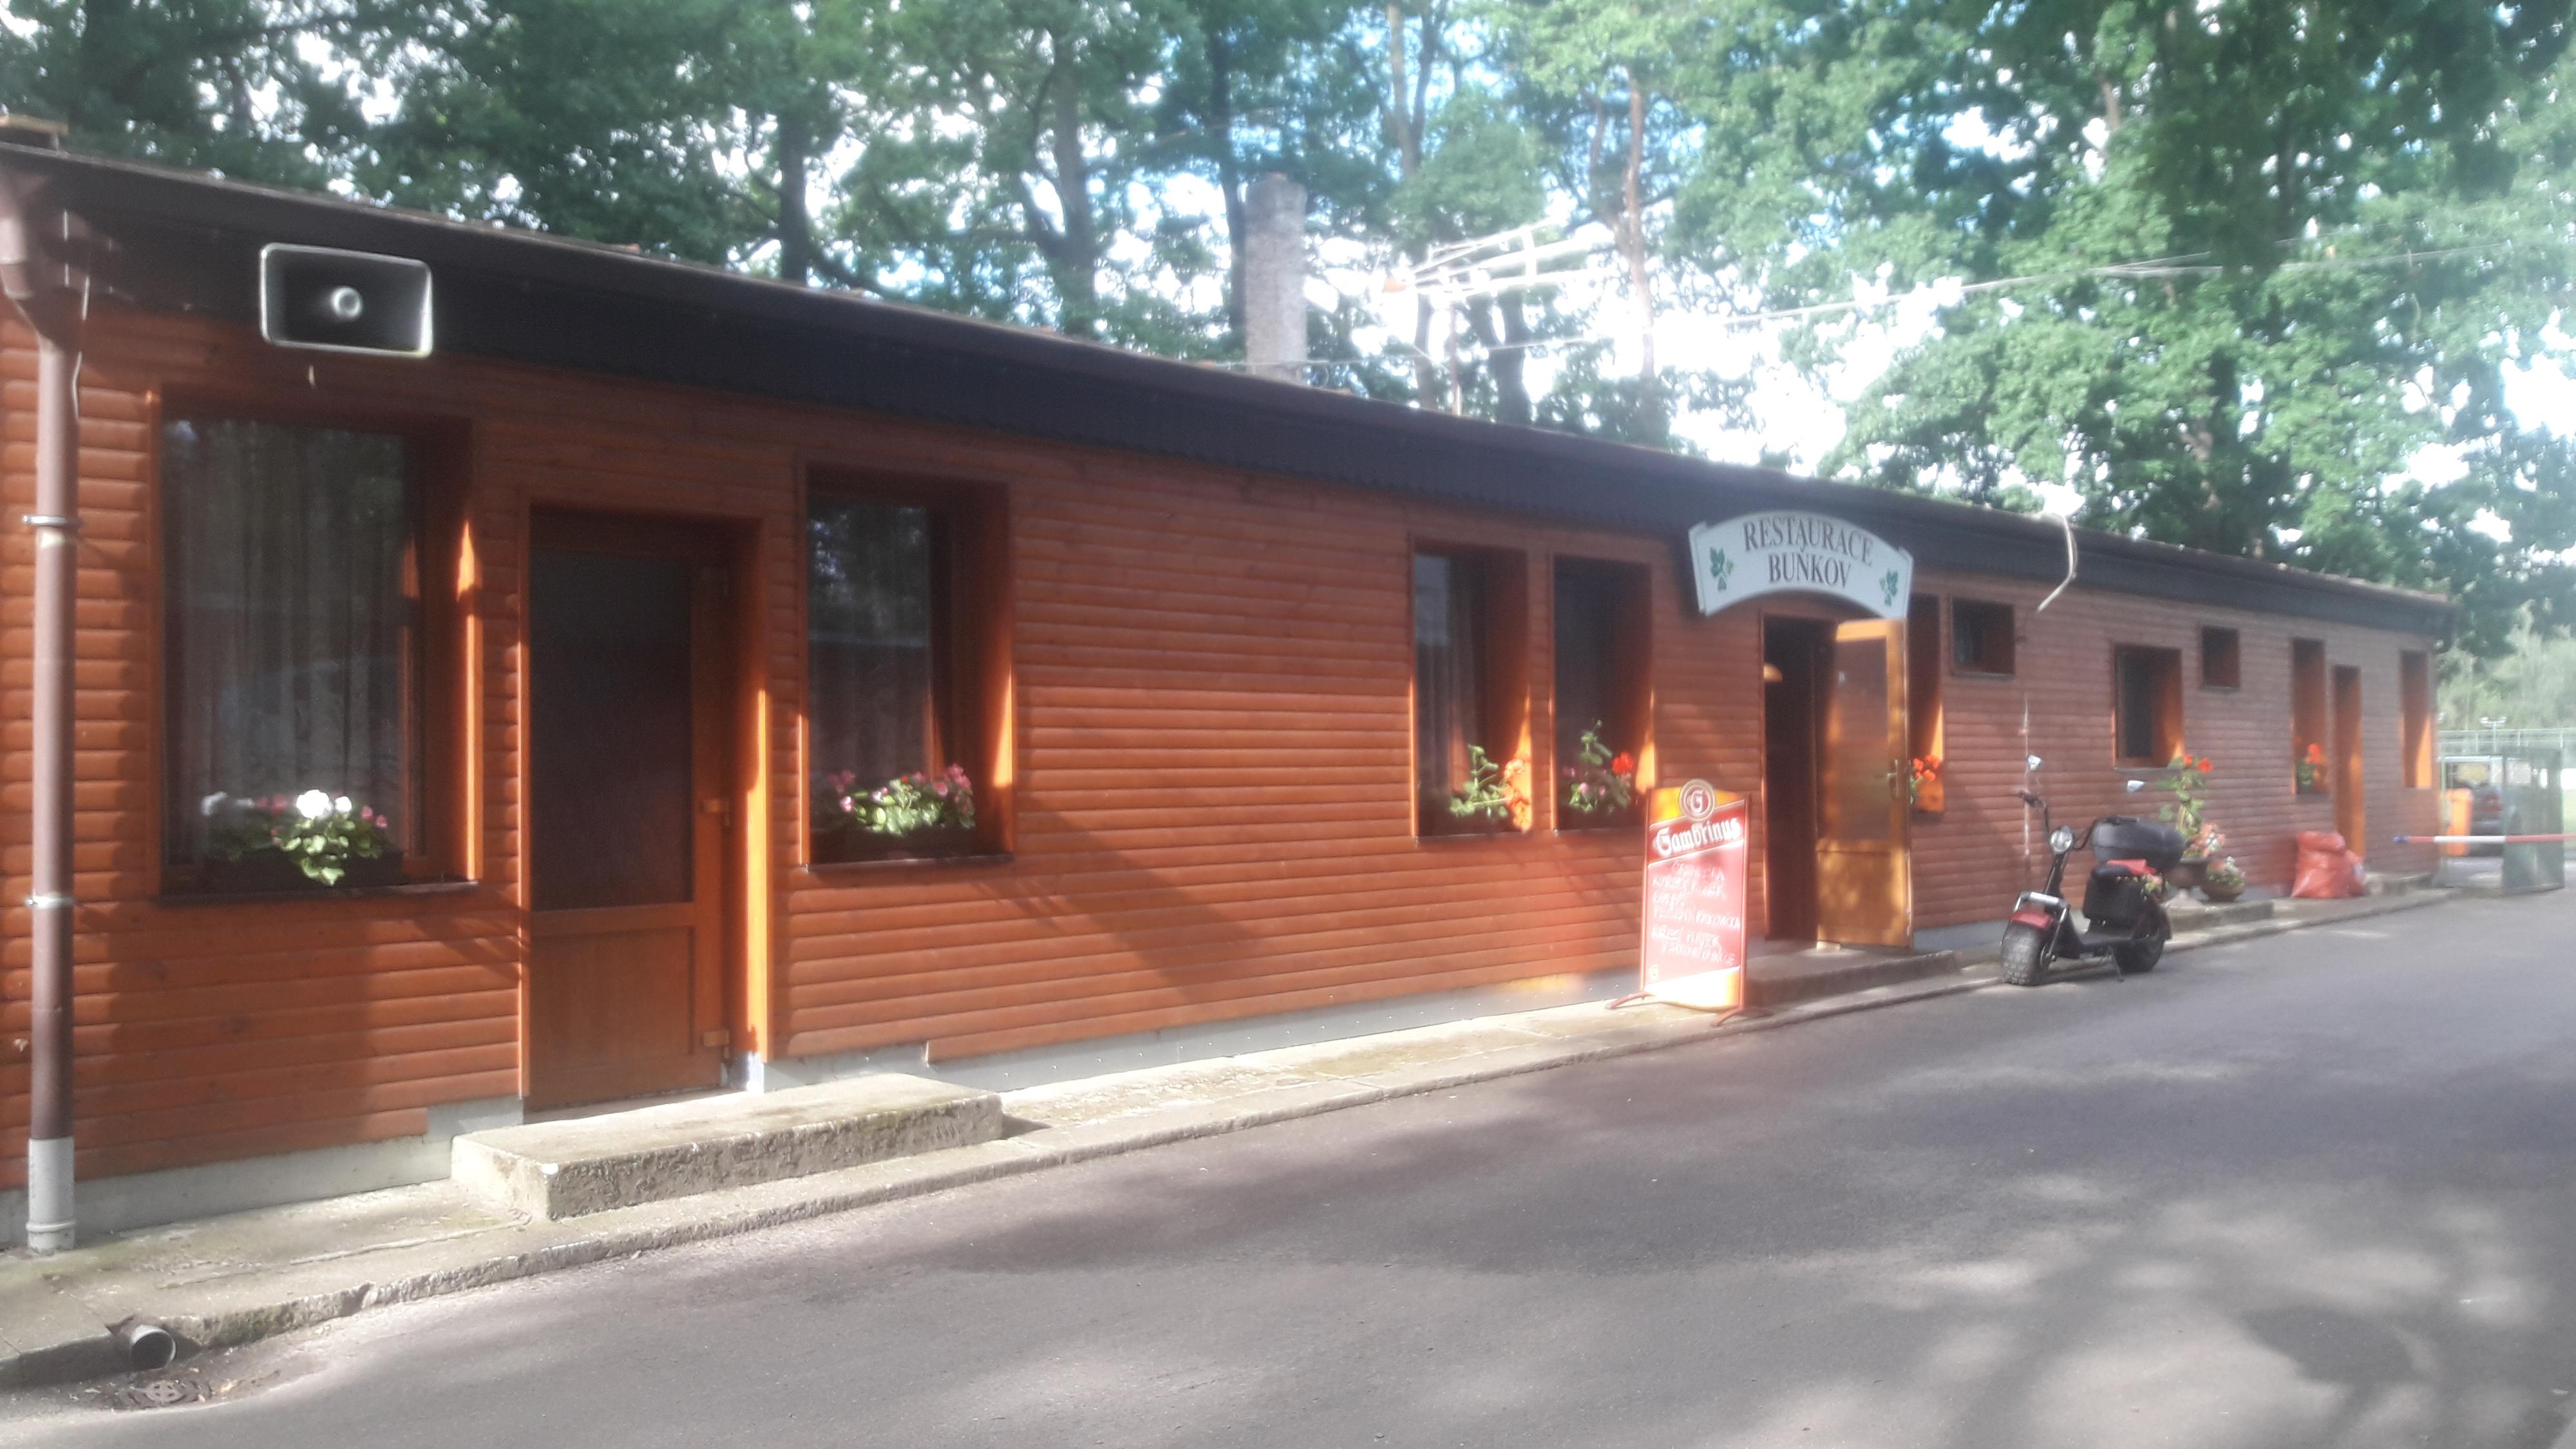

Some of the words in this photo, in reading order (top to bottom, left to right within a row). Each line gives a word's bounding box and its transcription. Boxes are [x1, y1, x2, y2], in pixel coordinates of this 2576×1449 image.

[1744, 516, 1873, 566] RESTAURACE
[1769, 546, 1851, 587] BUŇKOV
[1654, 817, 1741, 856] Gambrinus
